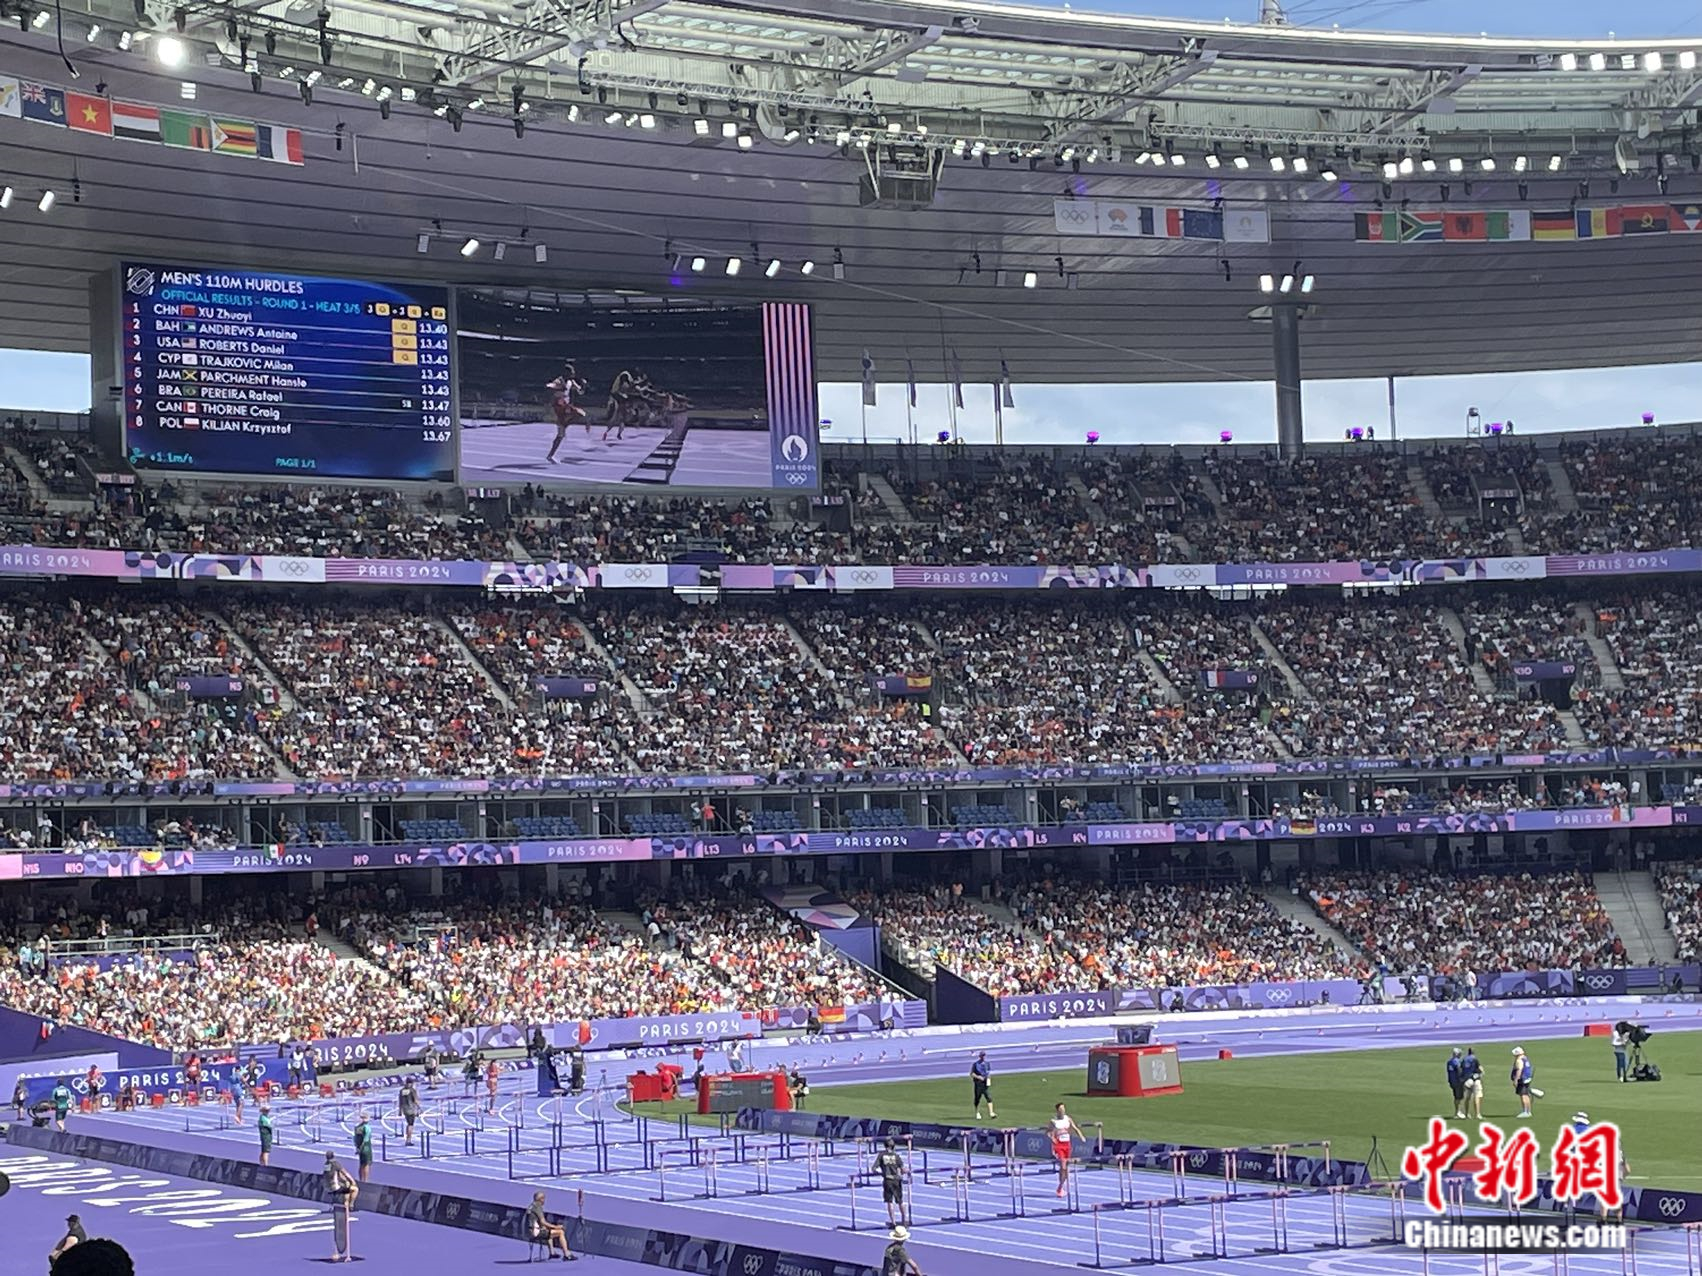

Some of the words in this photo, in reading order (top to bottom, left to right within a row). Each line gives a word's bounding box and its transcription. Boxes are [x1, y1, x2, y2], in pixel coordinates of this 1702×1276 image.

[161, 271, 201, 287] MEN'S
[206, 276, 242, 290] 110M
[245, 280, 304, 294] HURDLES
[161, 289, 209, 303] OFFICIAL
[211, 293, 253, 306] RESULTS
[262, 297, 299, 309] ROUND
[301, 300, 306, 310] 1
[315, 301, 342, 313] HEAT
[132, 303, 140, 313] 1
[154, 304, 179, 316] CHN
[198, 308, 214, 319] XU
[217, 311, 252, 323] Zhuoyi
[419, 323, 448, 334] 13.40
[132, 319, 141, 330] 2
[155, 321, 180, 332] BAH
[199, 325, 255, 337] ANDREWS
[256, 330, 298, 341] Antoine
[420, 339, 448, 350] 13.43
[133, 335, 141, 346] 3
[156, 337, 181, 348] USA
[199, 339, 249, 353] ROBERTS
[251, 342, 285, 355] Daniel
[420, 354, 449, 365] 13.43
[133, 351, 142, 362] 4
[158, 353, 181, 364] CYP
[200, 355, 262, 370] TRAJKOVIC
[263, 359, 294, 371] Milan
[421, 369, 449, 380] 13.43
[133, 367, 142, 379] 5
[156, 369, 182, 380] JAM
[200, 371, 270, 386] PARCHMENT
[271, 375, 307, 387] Hansle
[421, 384, 449, 396] 13.43
[134, 384, 143, 395] 6
[158, 385, 182, 396] BRA
[200, 387, 248, 400] PEREIRA
[248, 391, 283, 402] Rafael
[422, 400, 450, 411] 13.47
[135, 400, 143, 410] 7
[156, 401, 182, 413] CAN
[202, 404, 248, 416] THORNE
[249, 406, 280, 420] Craig
[422, 415, 451, 427] 13.60
[135, 416, 144, 427] 8
[159, 417, 182, 428] POL
[202, 420, 241, 431] KILIAN
[242, 423, 292, 435] Krzysztof
[423, 431, 451, 442] 13.67
[301, 459, 316, 469] 1/1
[2, 554, 40, 567] ARIS
[46, 555, 91, 569] 2024
[1577, 558, 1622, 571] PARIS
[1627, 557, 1669, 568] 2024
[358, 565, 404, 578] PARIS
[409, 566, 450, 578] 2024
[923, 572, 966, 584] PARIS
[970, 572, 1009, 583] 2024
[1246, 570, 1288, 580] PARIS
[1292, 569, 1331, 579] 2024
[1554, 815, 1591, 824] PARIS
[1596, 814, 1615, 822] 20
[1675, 813, 1688, 823] K1
[1096, 828, 1131, 840] PARIS
[1135, 827, 1167, 838] 2024
[1319, 822, 1351, 832] 2024
[1361, 824, 1374, 833] K3
[1397, 823, 1411, 832] K2
[835, 837, 871, 847] PARIS
[874, 836, 908, 846] 2024
[548, 847, 585, 857] PARIS
[589, 845, 623, 855] 2024
[704, 844, 720, 855] L13
[743, 843, 755, 854] L6
[233, 856, 272, 866] PARIS
[276, 853, 312, 865] 2024
[1009, 1000, 1057, 1016] PARIS
[1063, 998, 1106, 1013] 2024
[639, 1022, 689, 1037] PARIS
[695, 1020, 740, 1035] 2024
[344, 1042, 388, 1060] 2024
[119, 1072, 170, 1089] PARIS
[175, 1069, 220, 1084] 224
[102, 1096, 109, 1106] 8
[170, 1091, 179, 1102] 6
